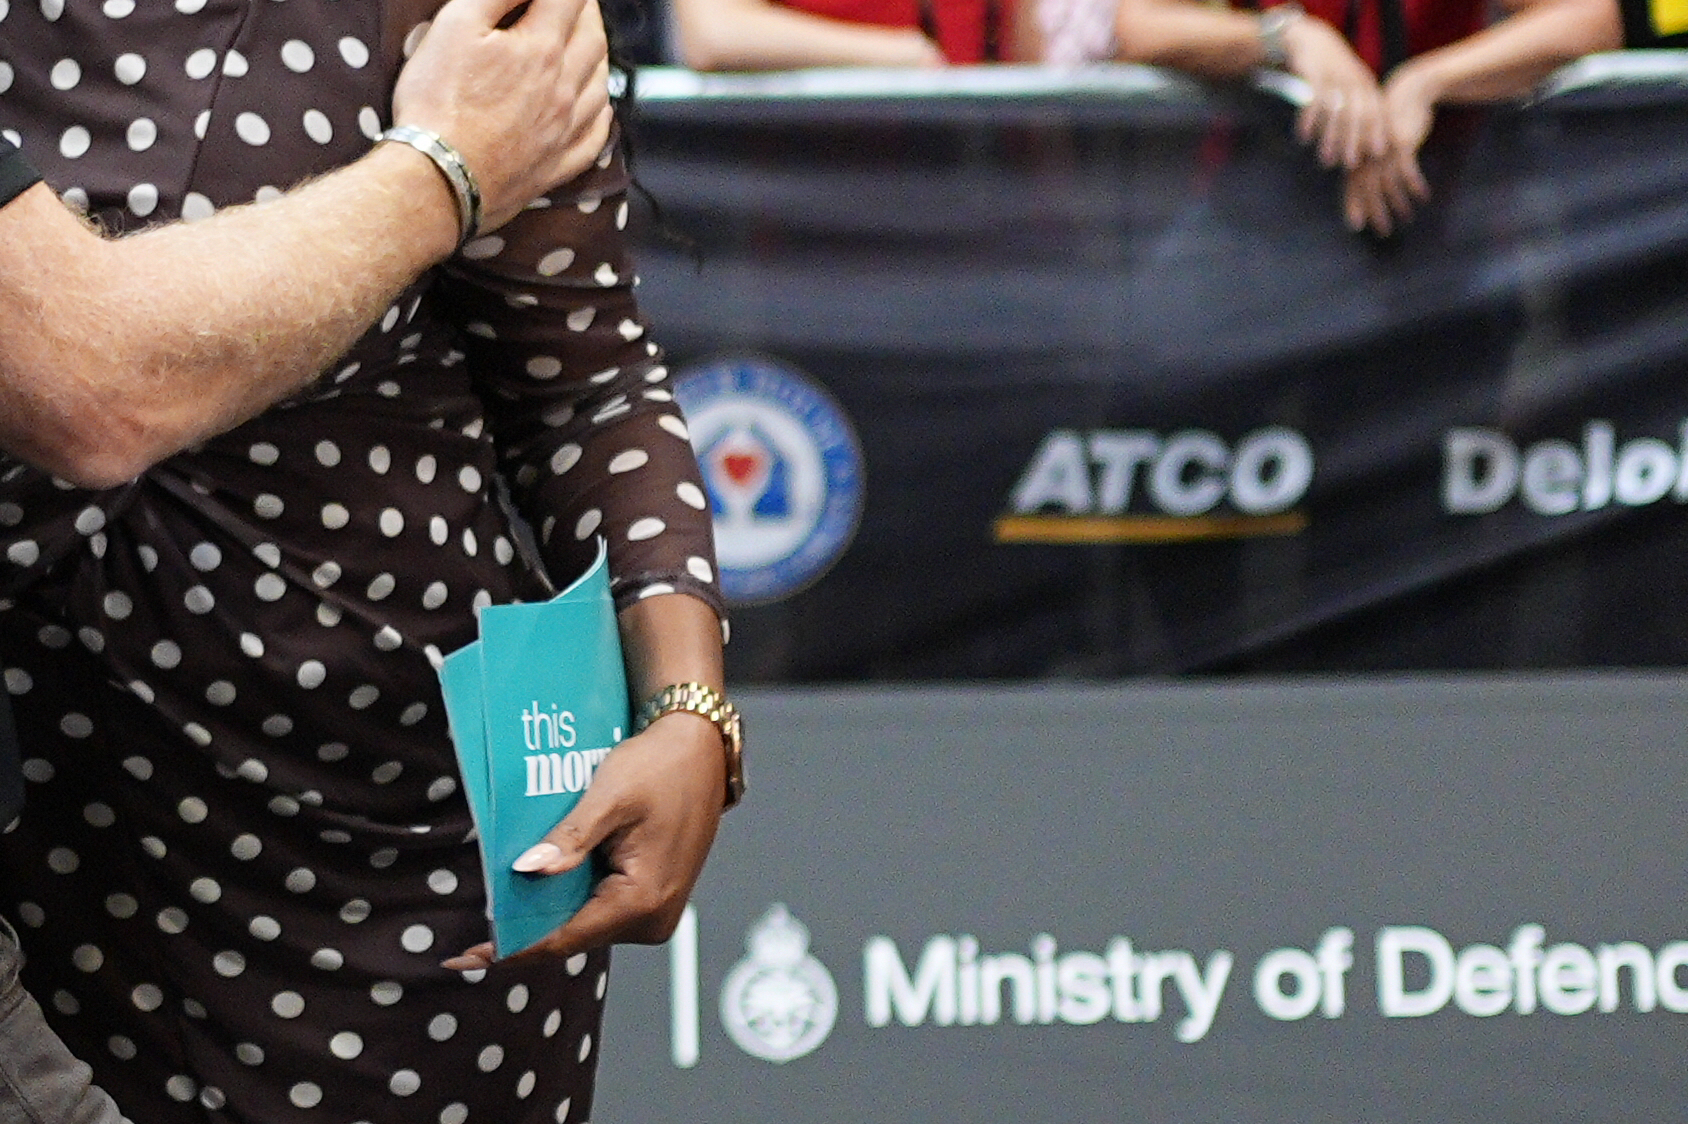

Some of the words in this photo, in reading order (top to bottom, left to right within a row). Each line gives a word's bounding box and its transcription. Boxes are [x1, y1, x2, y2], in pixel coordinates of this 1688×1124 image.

[1012, 427, 1313, 517] ATCO
[521, 700, 577, 751] this
[863, 933, 1234, 1044] Ministry
[1254, 926, 1354, 1022] of
